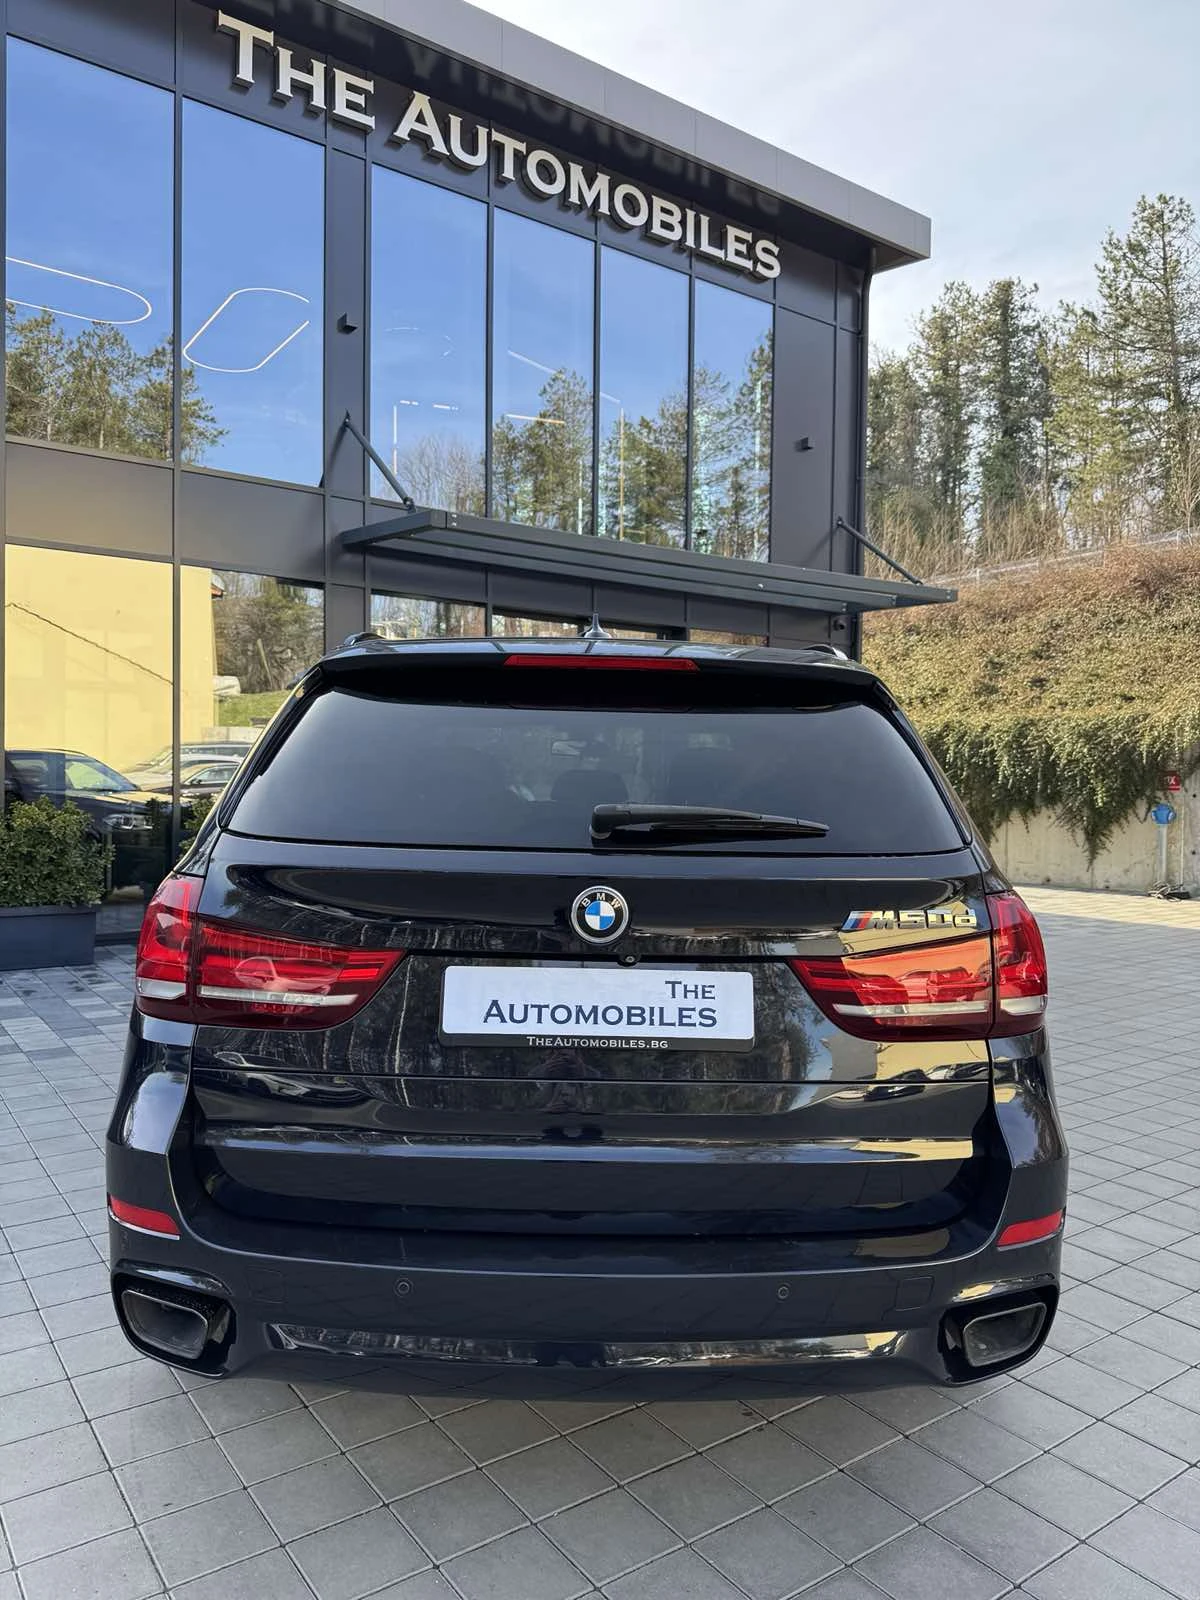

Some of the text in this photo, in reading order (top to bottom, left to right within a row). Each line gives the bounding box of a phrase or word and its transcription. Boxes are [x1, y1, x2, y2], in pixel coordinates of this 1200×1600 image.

[217, 11, 375, 131] THE
[394, 92, 782, 279] AUTOMOBILES
[581, 892, 622, 909] BMW
[843, 910, 977, 929] M50d
[665, 980, 716, 1000] THE
[482, 999, 718, 1028] AUTOMOBILES
